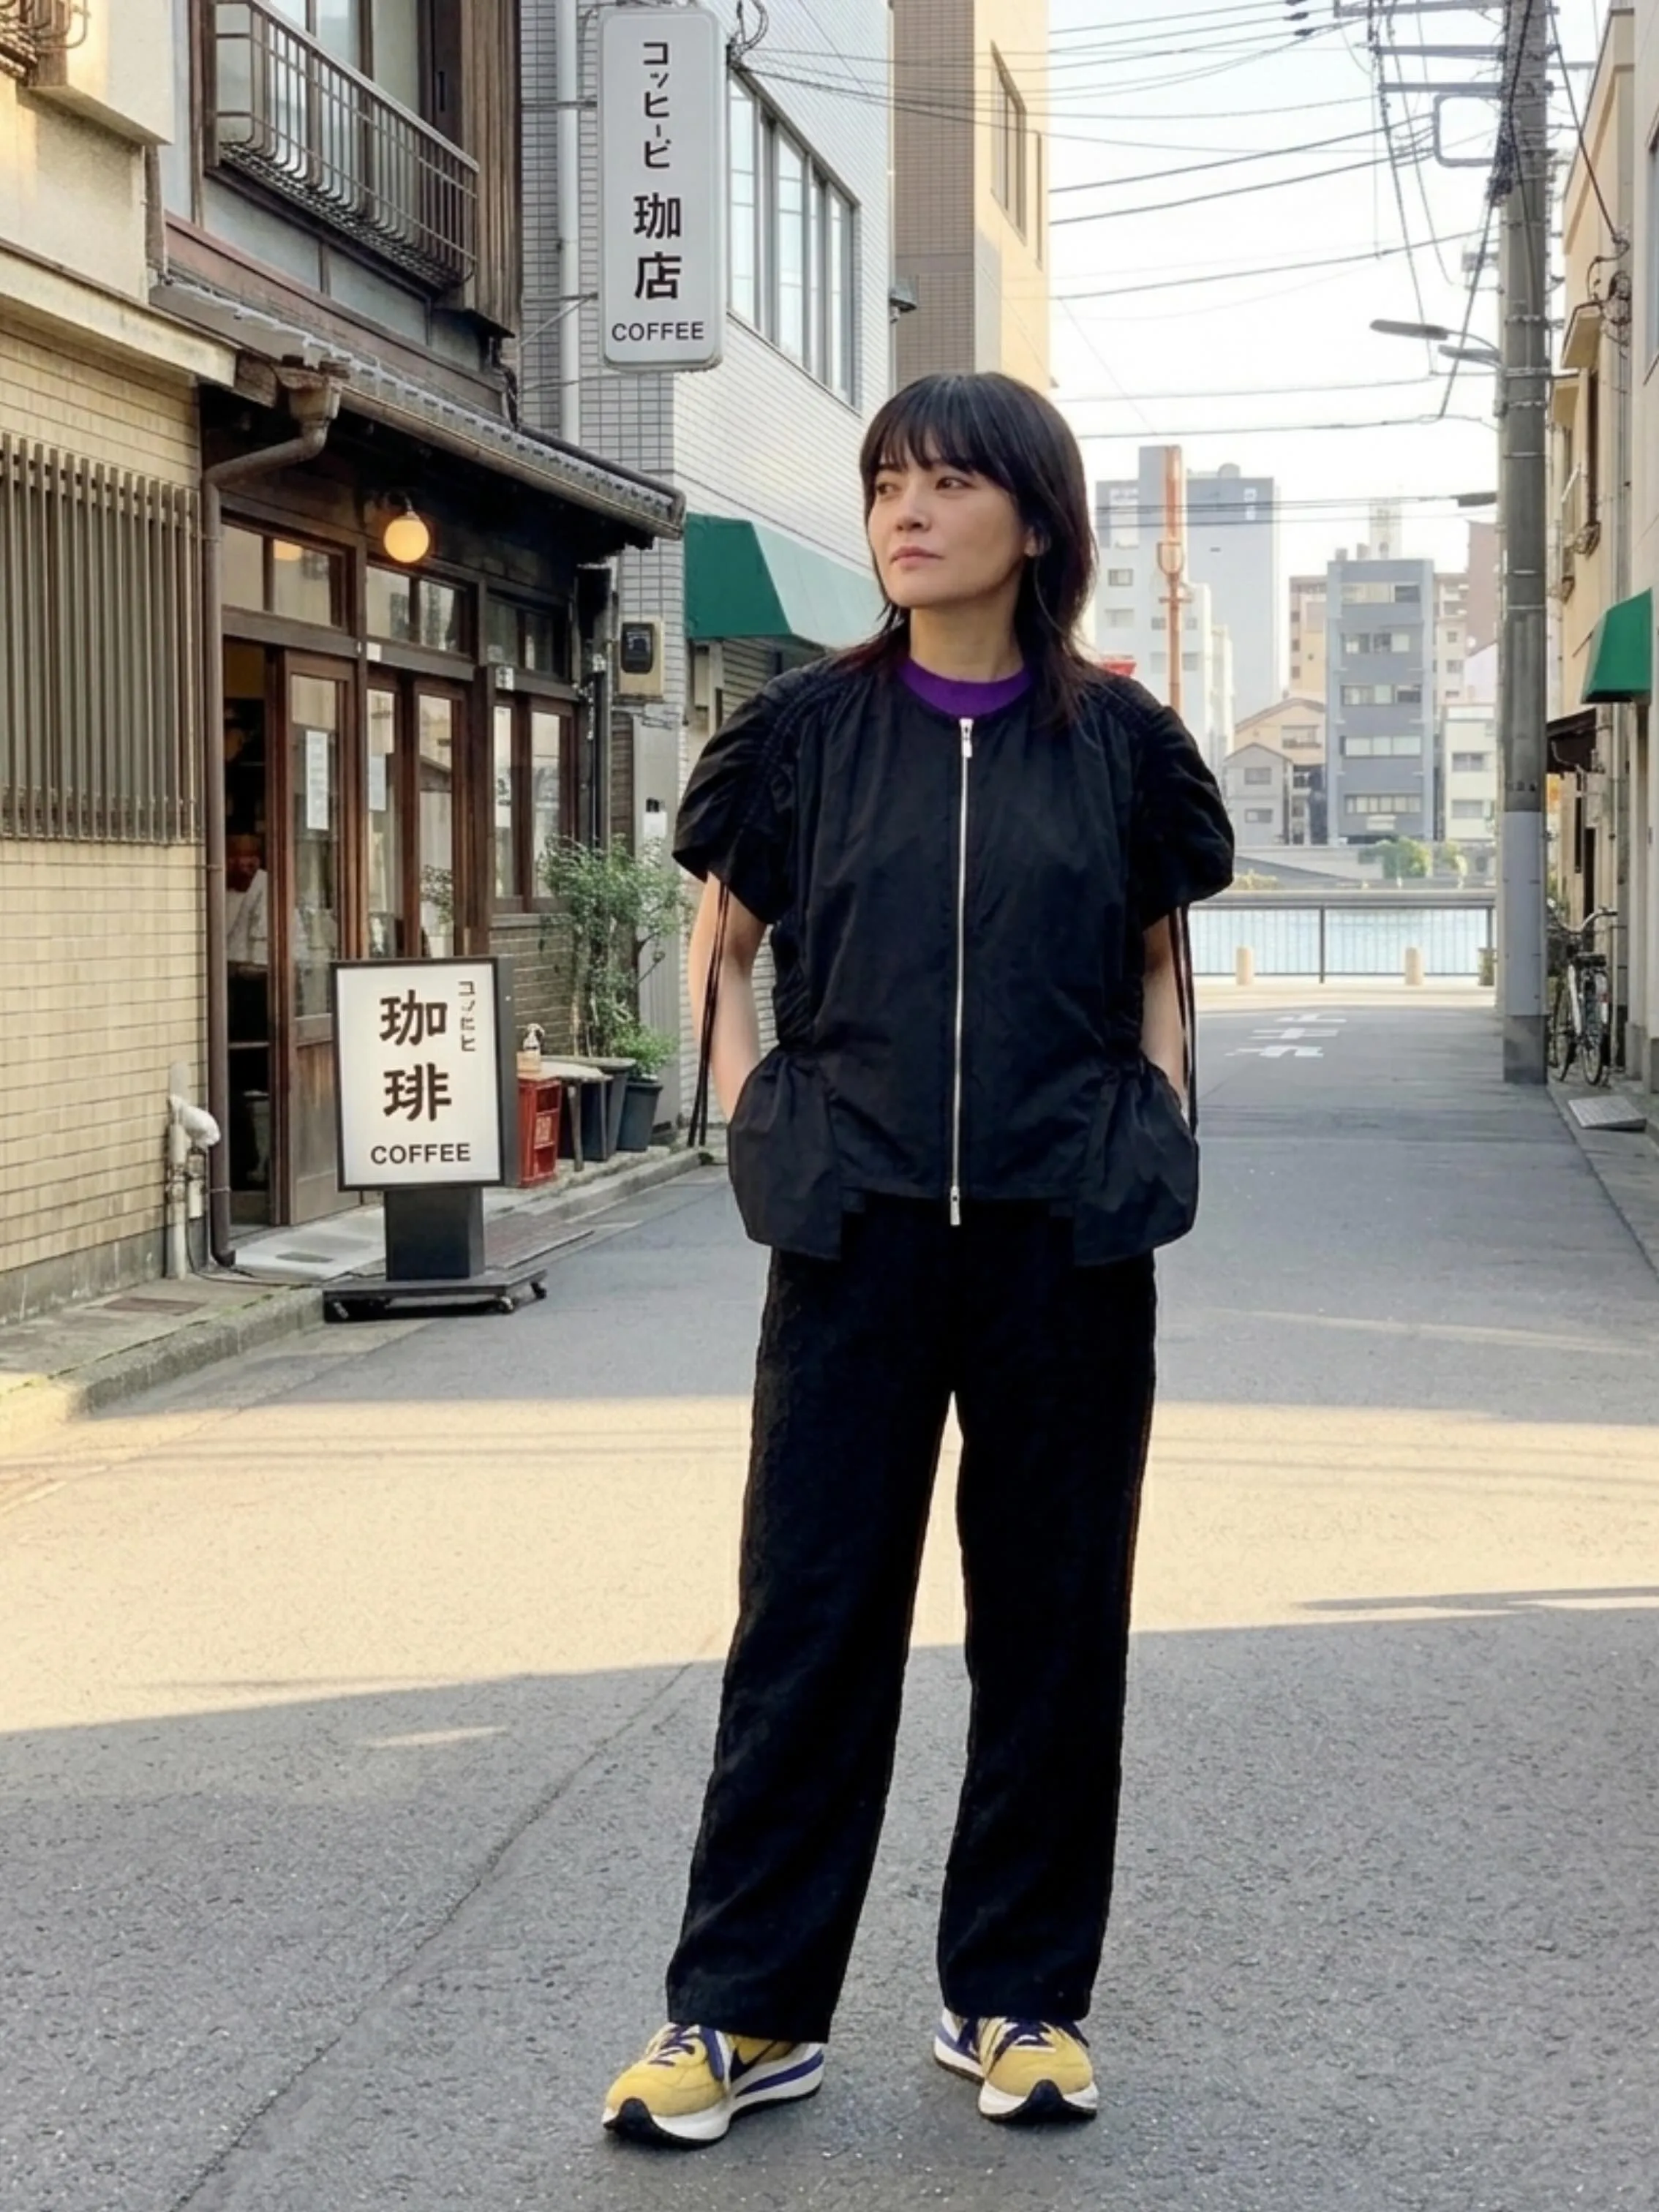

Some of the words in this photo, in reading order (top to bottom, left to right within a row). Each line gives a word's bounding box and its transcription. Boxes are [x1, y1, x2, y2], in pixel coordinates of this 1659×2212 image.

[633, 192, 682, 300] 珈店
[611, 321, 704, 342] COFFEE
[379, 989, 452, 1122] 珈琲
[370, 1143, 470, 1165] COFFEE
